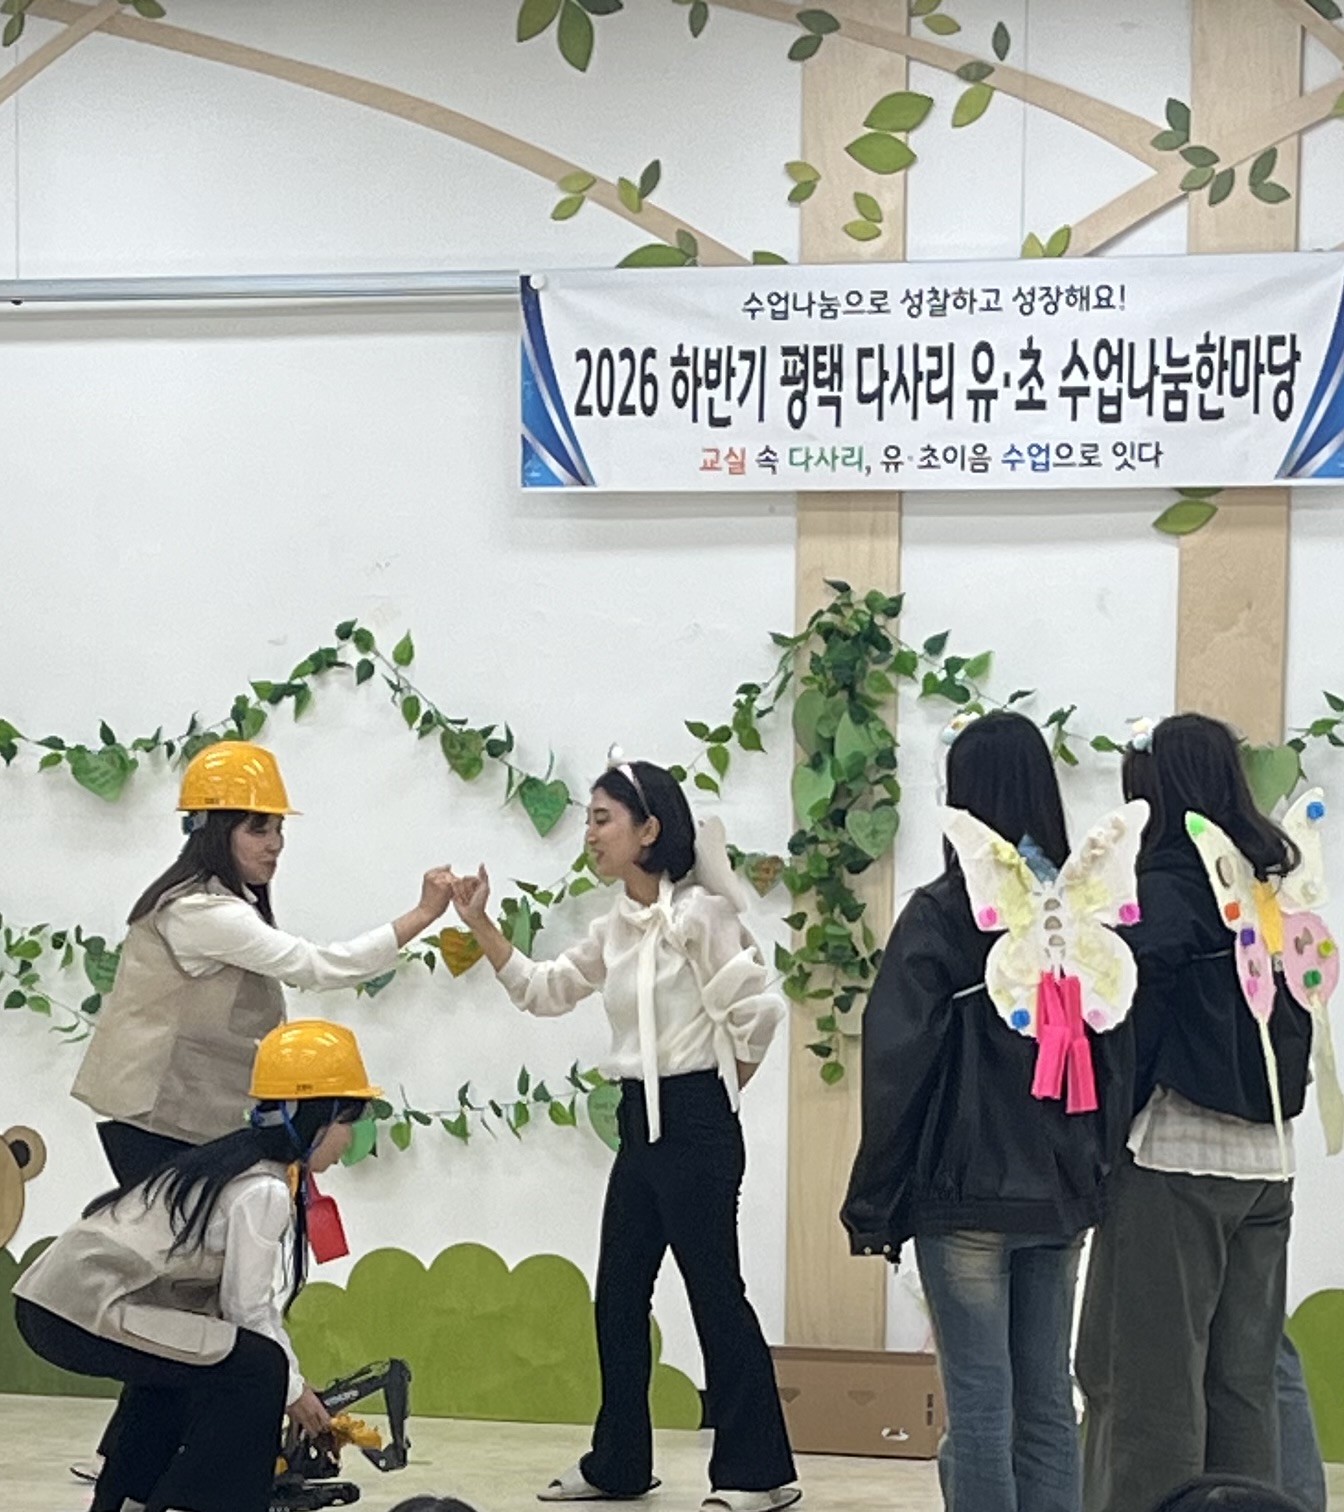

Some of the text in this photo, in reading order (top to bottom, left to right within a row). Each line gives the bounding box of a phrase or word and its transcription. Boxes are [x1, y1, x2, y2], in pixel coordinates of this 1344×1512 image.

[741, 283, 1126, 321] 수업나눔으로 성찰하고 성장해요!
[573, 346, 659, 418] 2026
[669, 342, 767, 429] 하반기
[779, 343, 844, 431] 평택
[856, 341, 955, 422] 다사리
[1057, 330, 1303, 424] 수업나눔한마당
[699, 446, 746, 476] 교실
[755, 444, 780, 476] 속
[788, 445, 872, 477] 다사리,
[1000, 442, 1103, 473] 수업으로
[1111, 440, 1165, 472] 잇다
